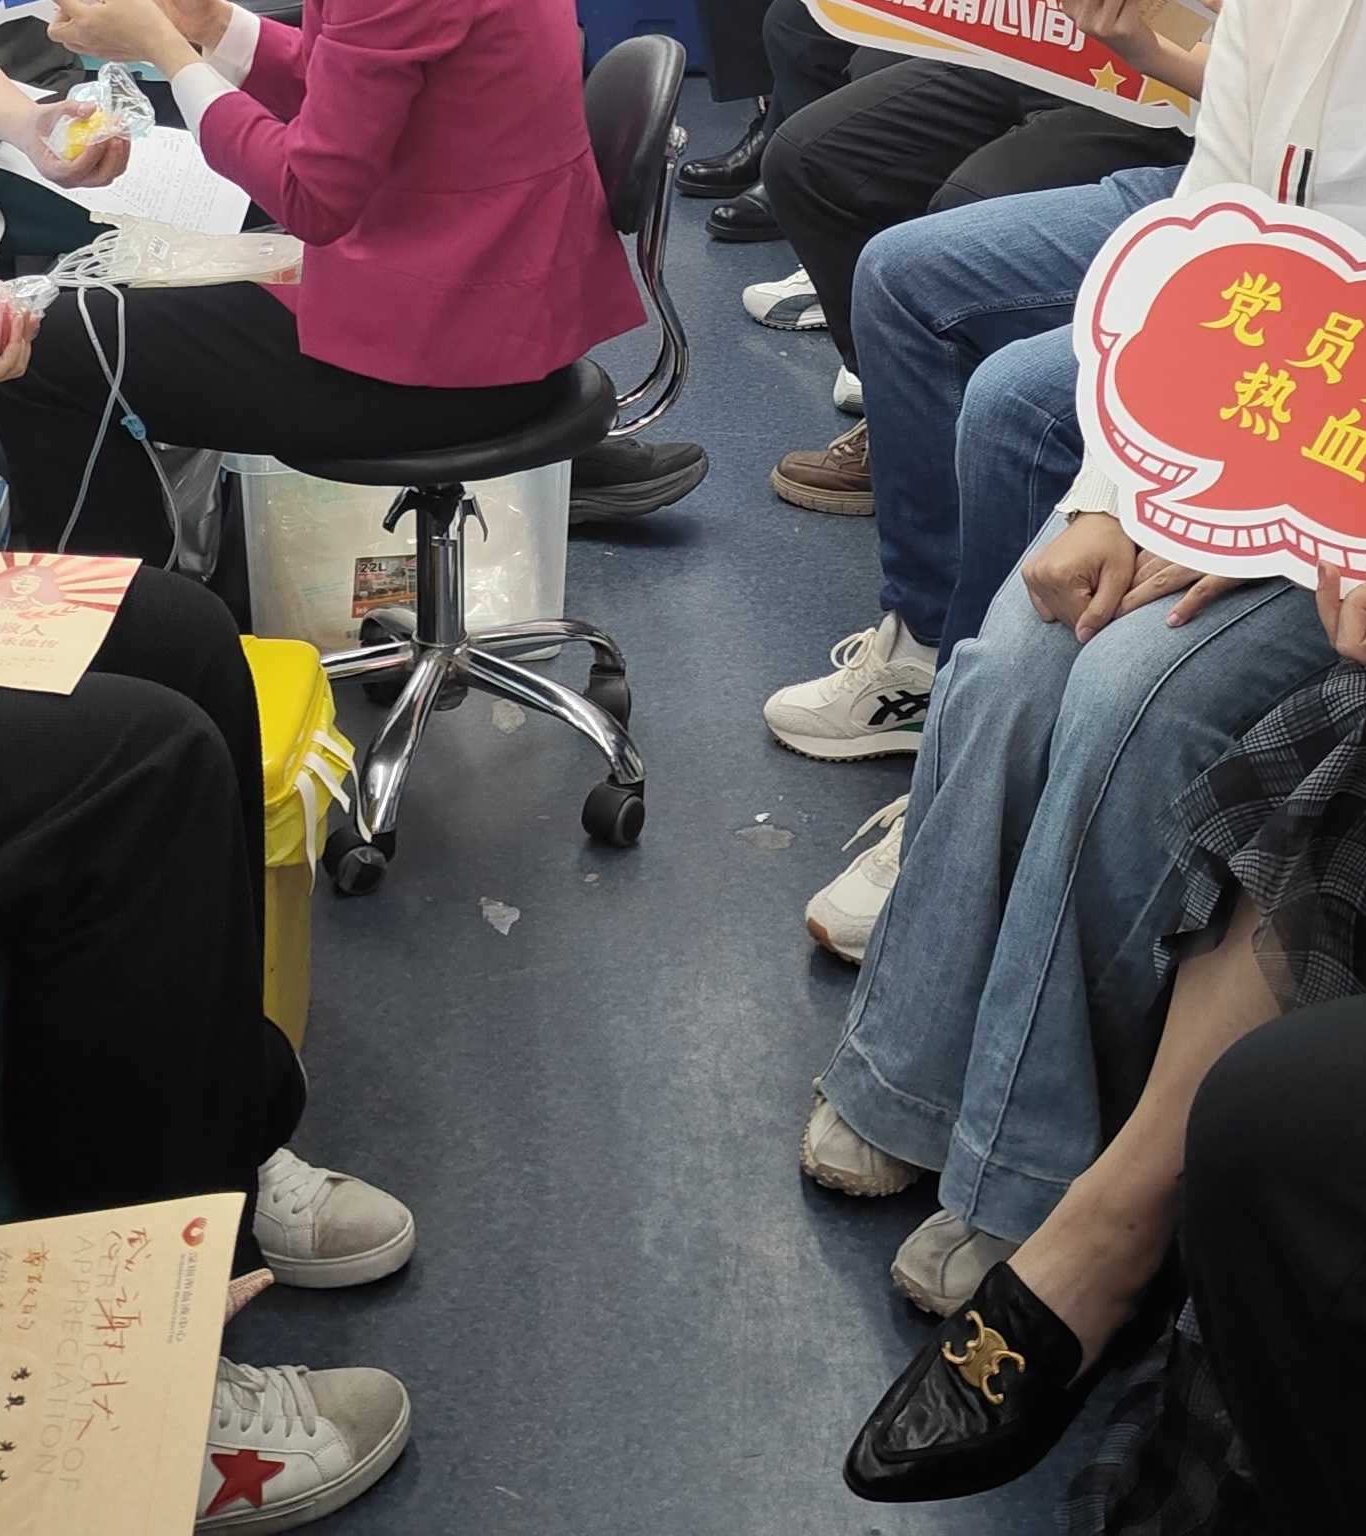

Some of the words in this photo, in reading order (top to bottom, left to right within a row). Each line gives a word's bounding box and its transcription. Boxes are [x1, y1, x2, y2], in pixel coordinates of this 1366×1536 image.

[359, 562, 387, 573] 22L
[34, 1235, 96, 1475] APPRECIATION
[75, 1227, 153, 1441] 感谢状
